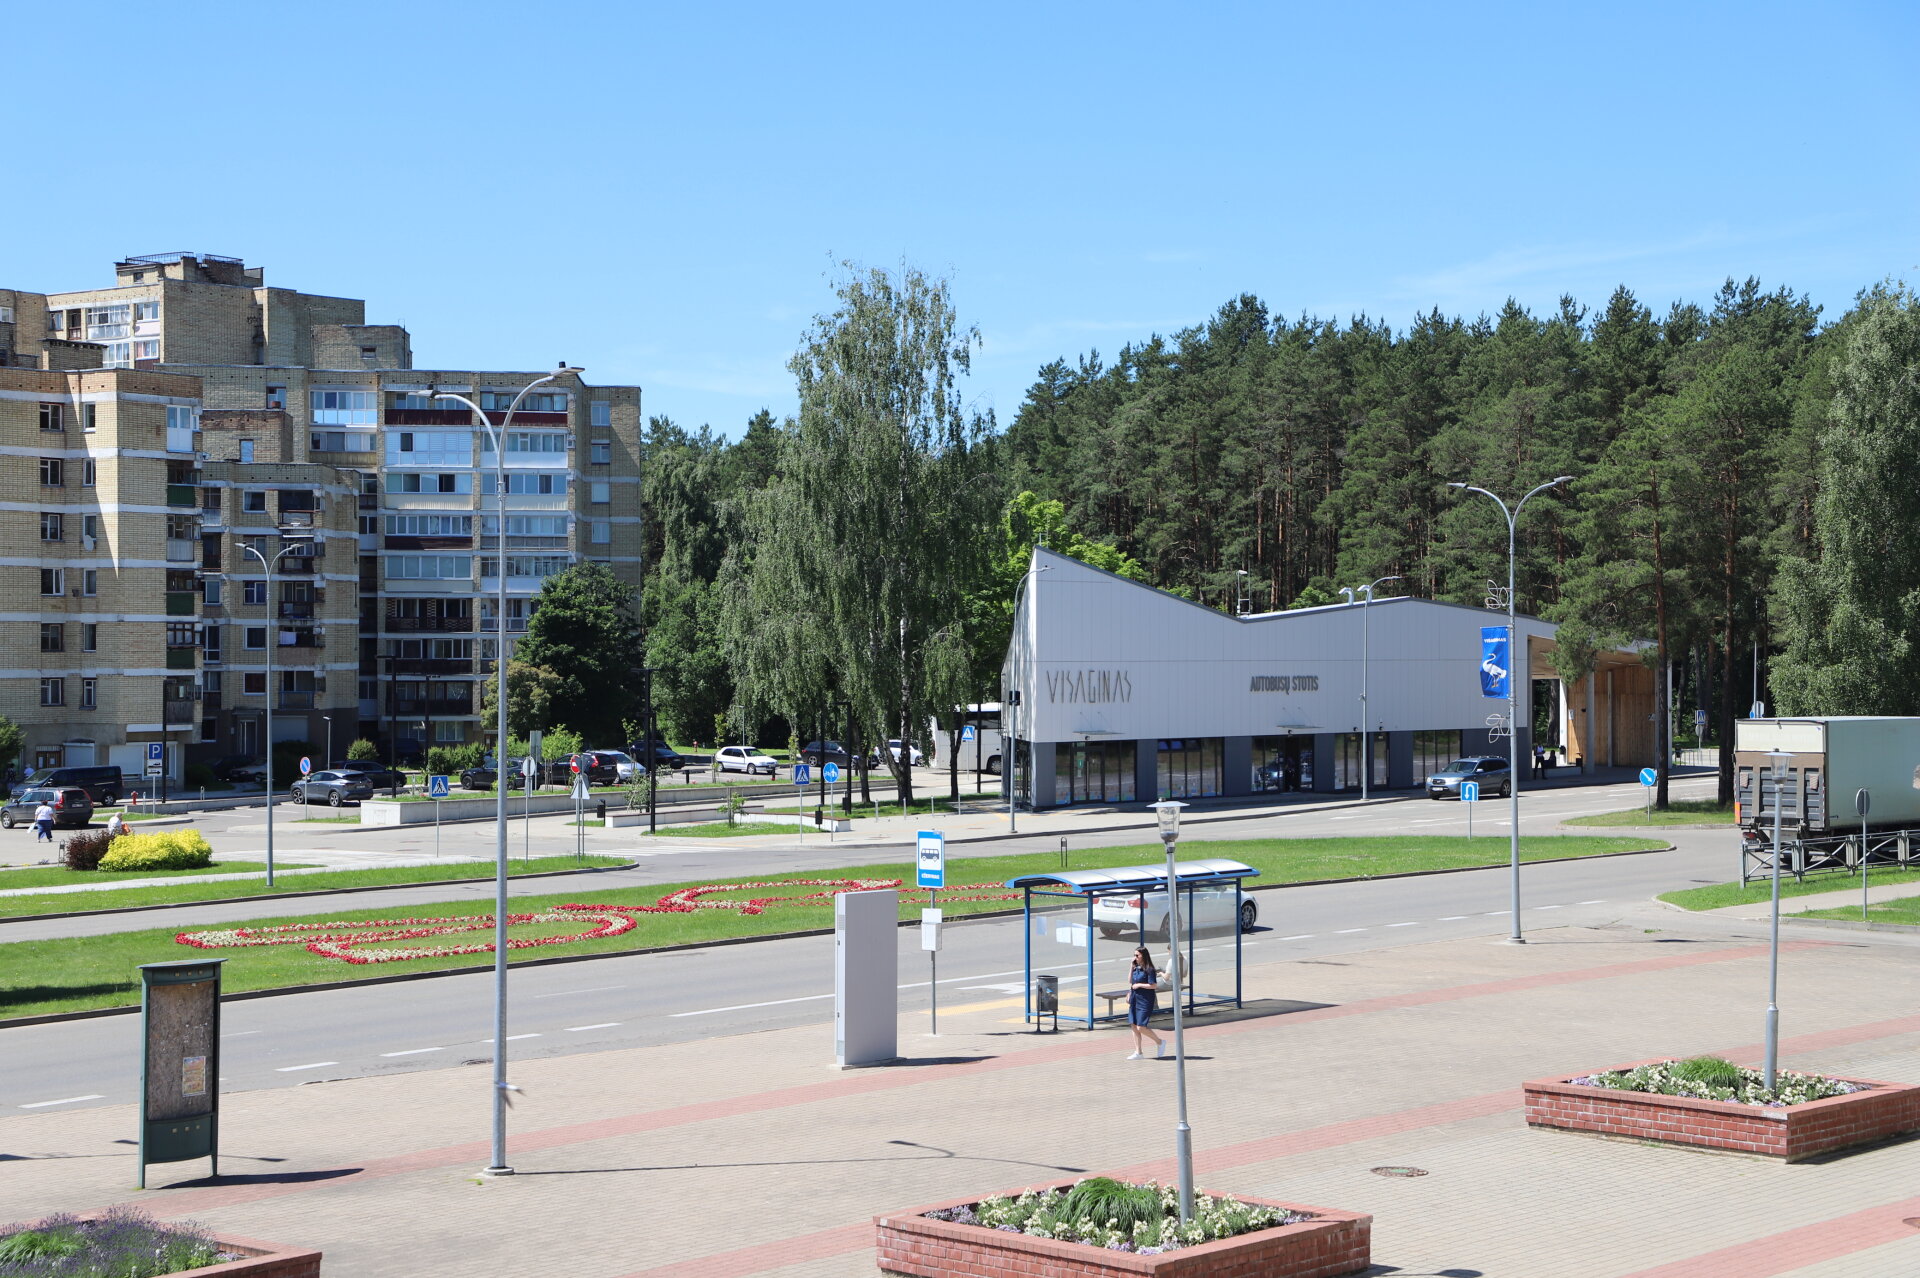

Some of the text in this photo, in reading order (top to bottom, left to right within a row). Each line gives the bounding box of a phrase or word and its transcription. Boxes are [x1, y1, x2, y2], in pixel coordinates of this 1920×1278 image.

[1046, 670, 1131, 704] VISAGINAS
[1250, 675, 1319, 696] AUTOBUSŲ STOTIS
[152, 745, 160, 758] P
